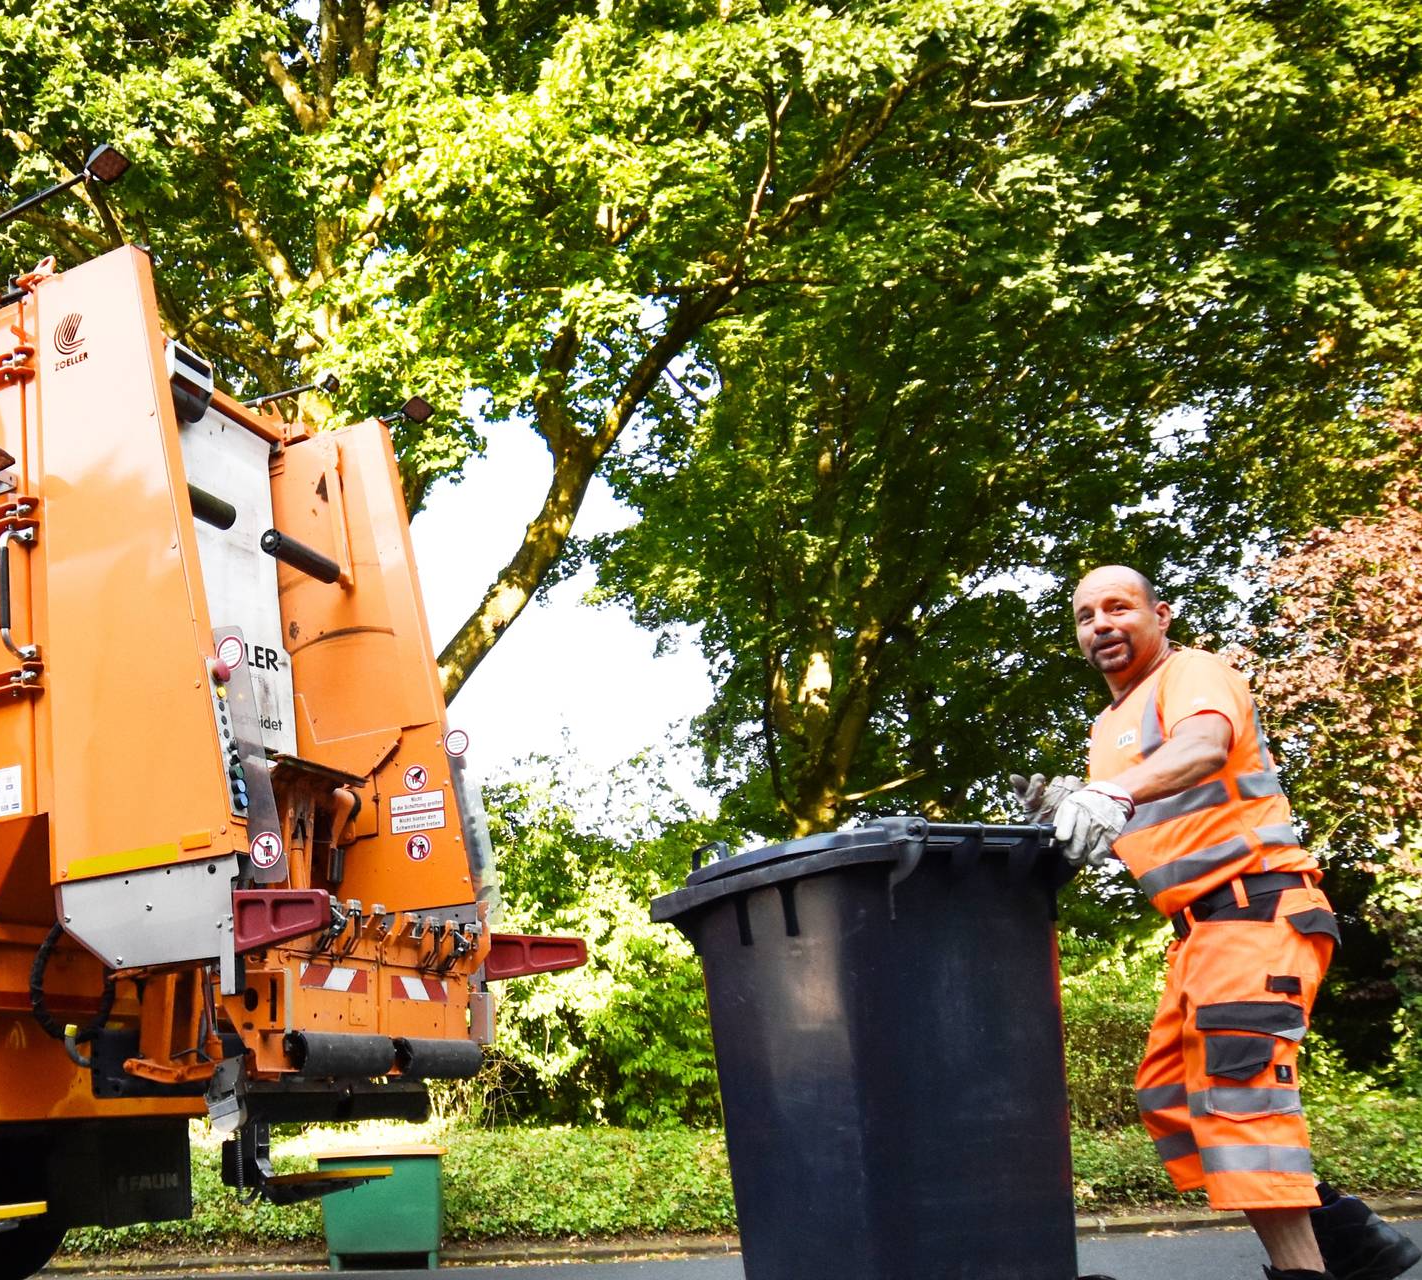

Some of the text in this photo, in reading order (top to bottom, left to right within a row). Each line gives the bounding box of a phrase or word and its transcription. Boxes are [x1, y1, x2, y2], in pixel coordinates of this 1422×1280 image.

[55, 352, 88, 371] ZOELLER
[245, 643, 279, 672] LER
[259, 715, 282, 731] idet
